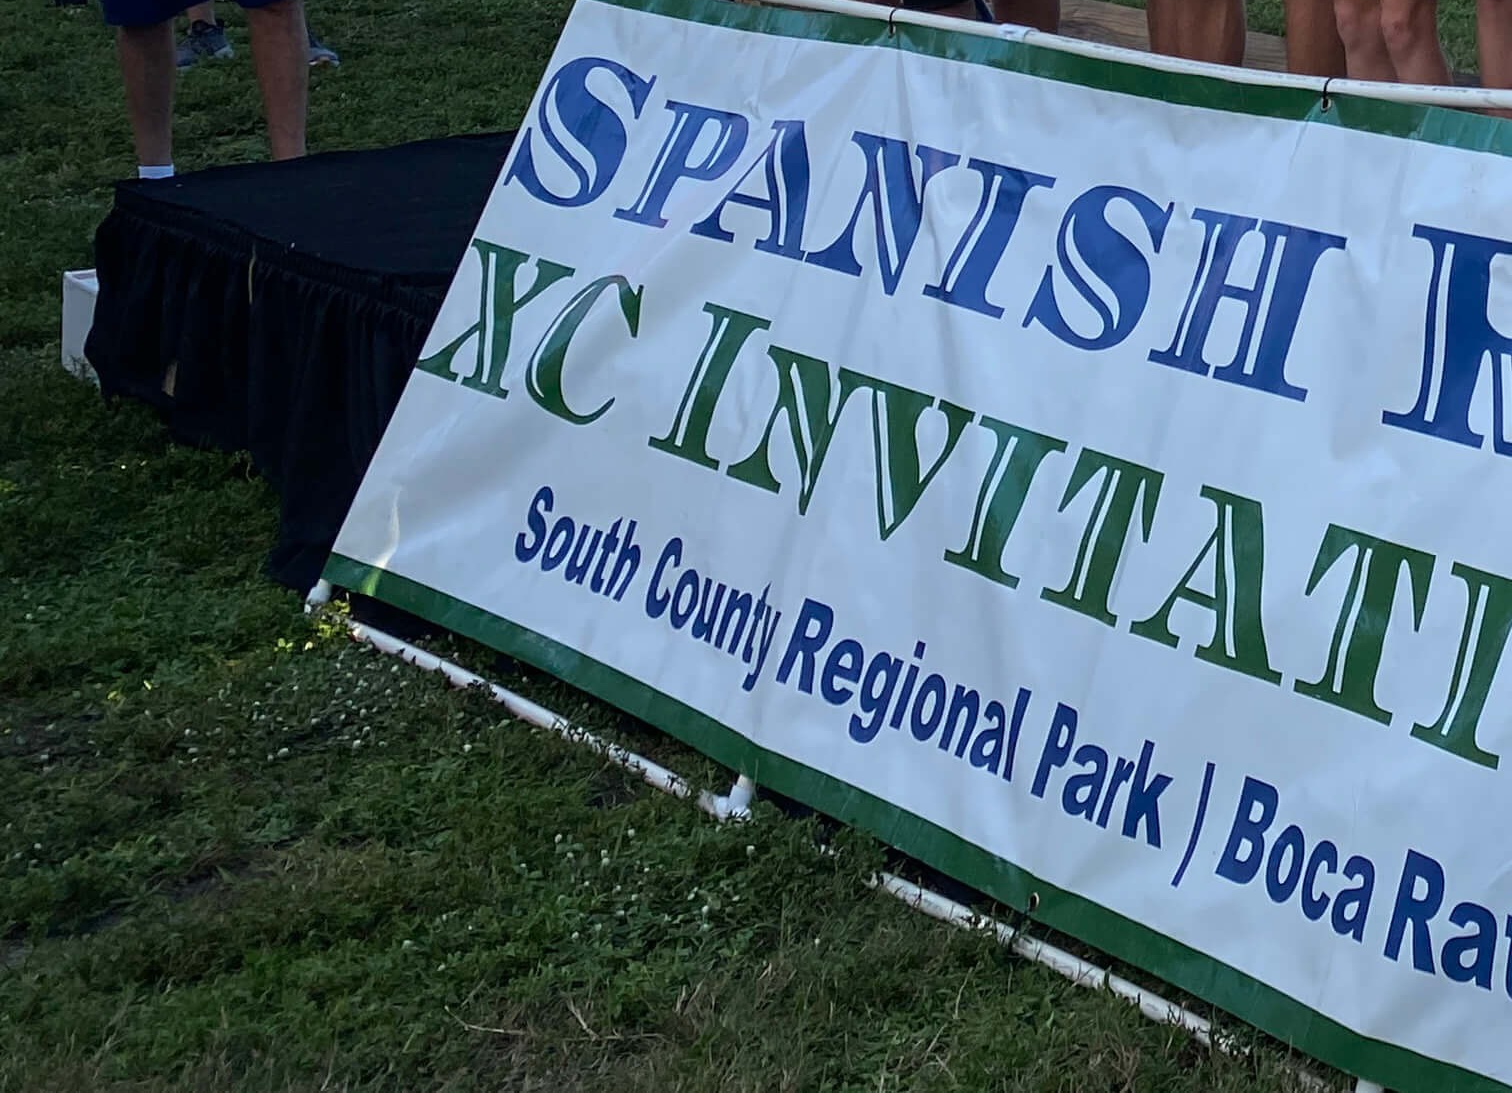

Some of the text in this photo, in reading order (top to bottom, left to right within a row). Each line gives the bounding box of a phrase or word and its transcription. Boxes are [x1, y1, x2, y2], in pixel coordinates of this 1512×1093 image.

[416, 238, 643, 425] XC
[503, 55, 1347, 403] SPANISH
[514, 485, 640, 602] South
[645, 536, 781, 692] County
[776, 597, 1031, 782] Regional
[1031, 701, 1175, 849] Park
[1215, 775, 1377, 943] Boca
